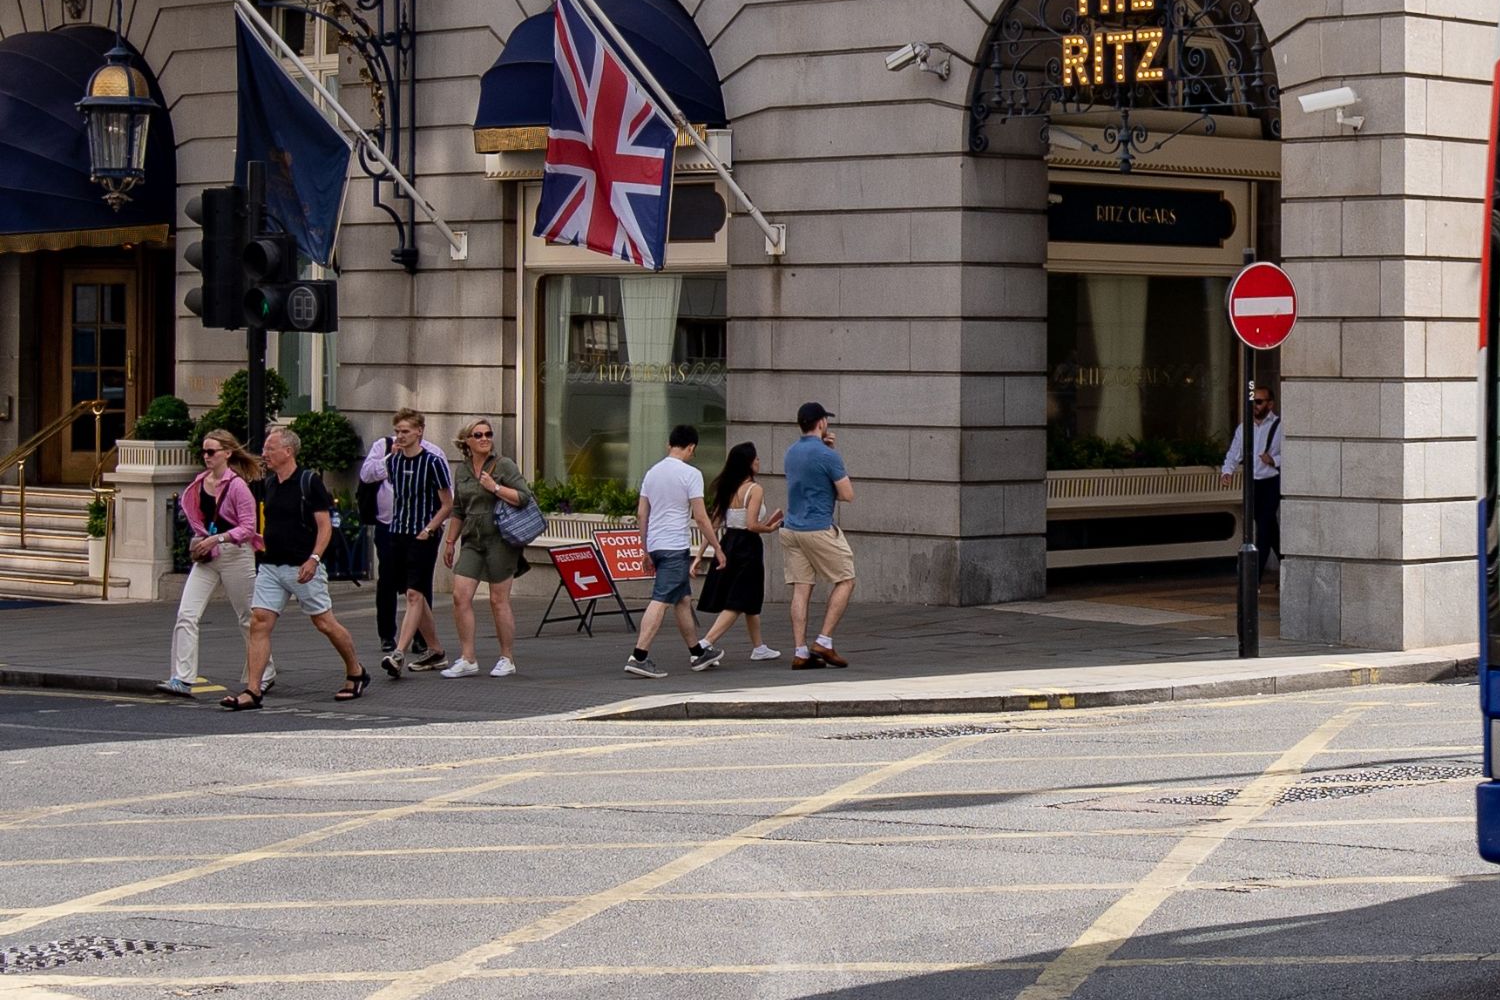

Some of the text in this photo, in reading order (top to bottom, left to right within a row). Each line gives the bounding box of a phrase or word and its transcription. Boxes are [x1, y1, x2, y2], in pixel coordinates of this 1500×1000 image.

[1062, 27, 1164, 87] RITZ
[1096, 205, 1177, 225] RITZ CIGARS
[600, 535, 641, 546] FOOTP
[555, 550, 593, 562] PEDESTRIANS
[616, 549, 645, 559] AHEA
[617, 561, 643, 572] CLO
